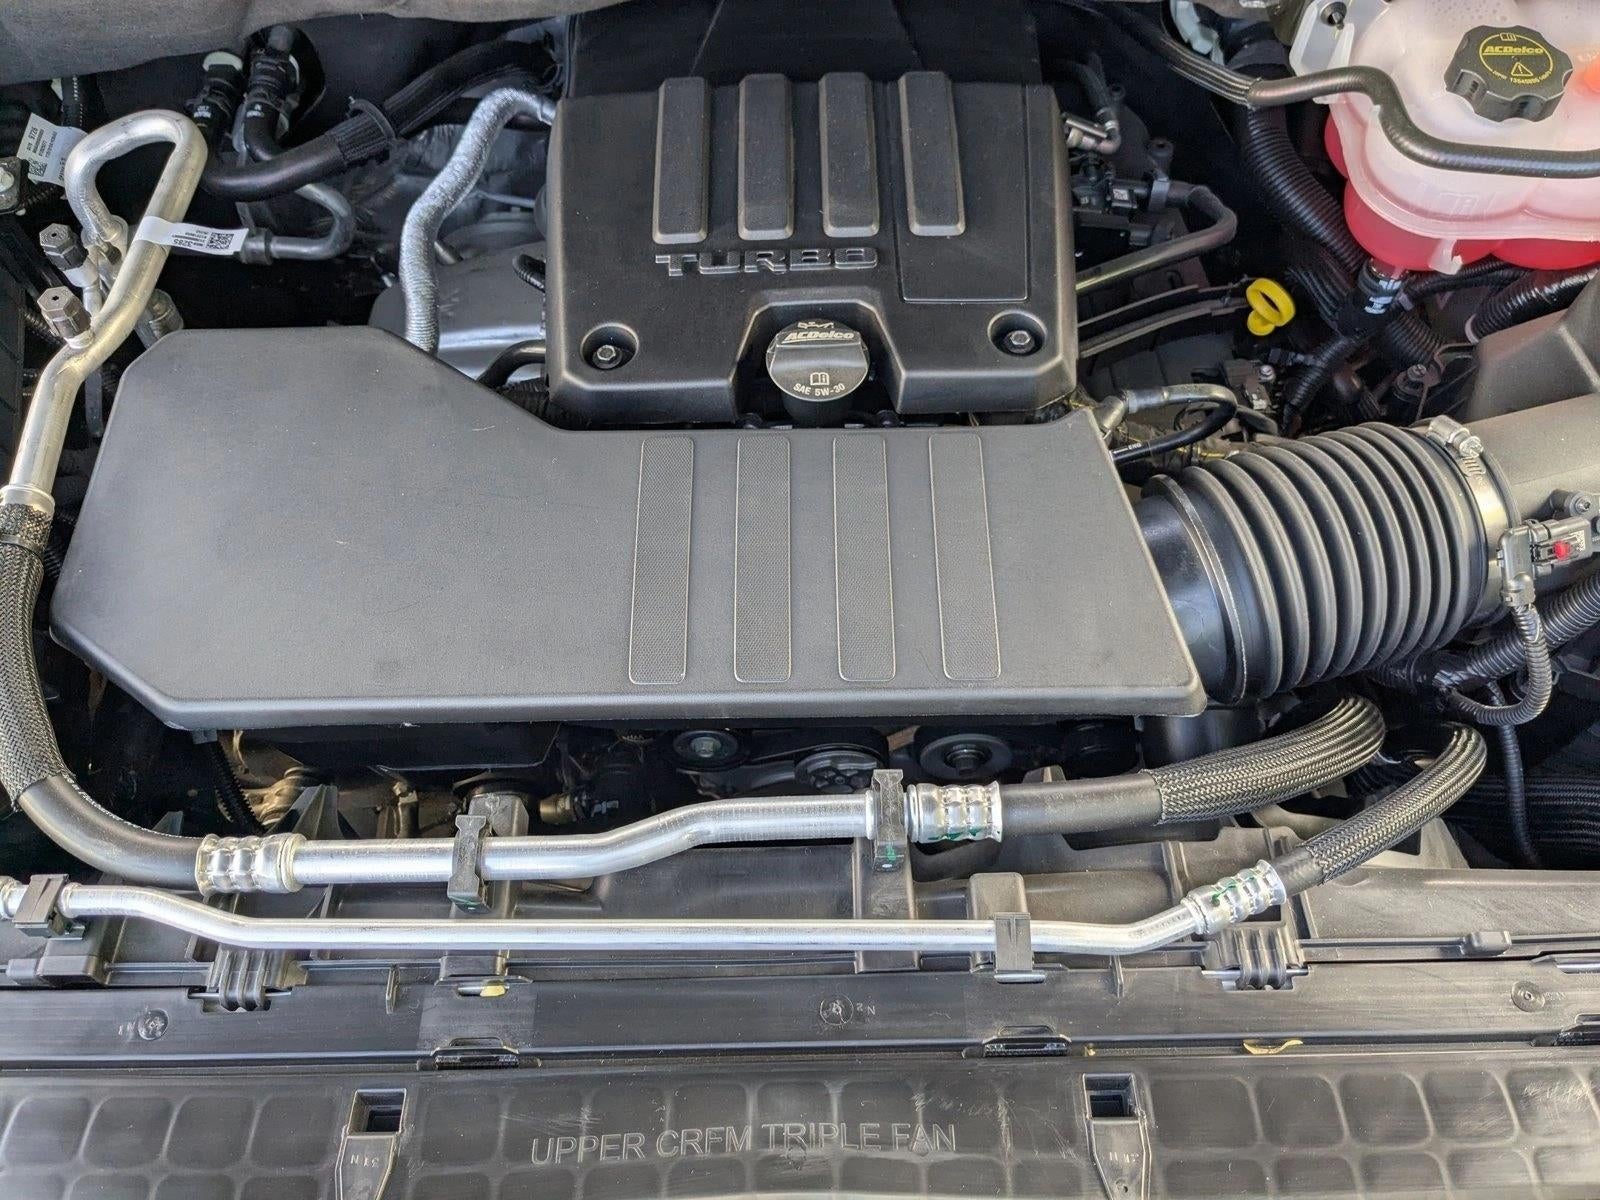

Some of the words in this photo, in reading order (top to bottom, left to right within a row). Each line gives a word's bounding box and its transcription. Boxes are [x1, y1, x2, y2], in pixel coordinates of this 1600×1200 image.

[1483, 45, 1544, 54] ACDelco
[655, 248, 878, 277] TURBO
[784, 330, 855, 342] ACDelco
[793, 382, 812, 395] SAE
[814, 383, 846, 396] 5W-30
[531, 1132, 647, 1166] UPPER
[761, 1122, 882, 1151] TRIPLE
[891, 1123, 957, 1153] FAN
